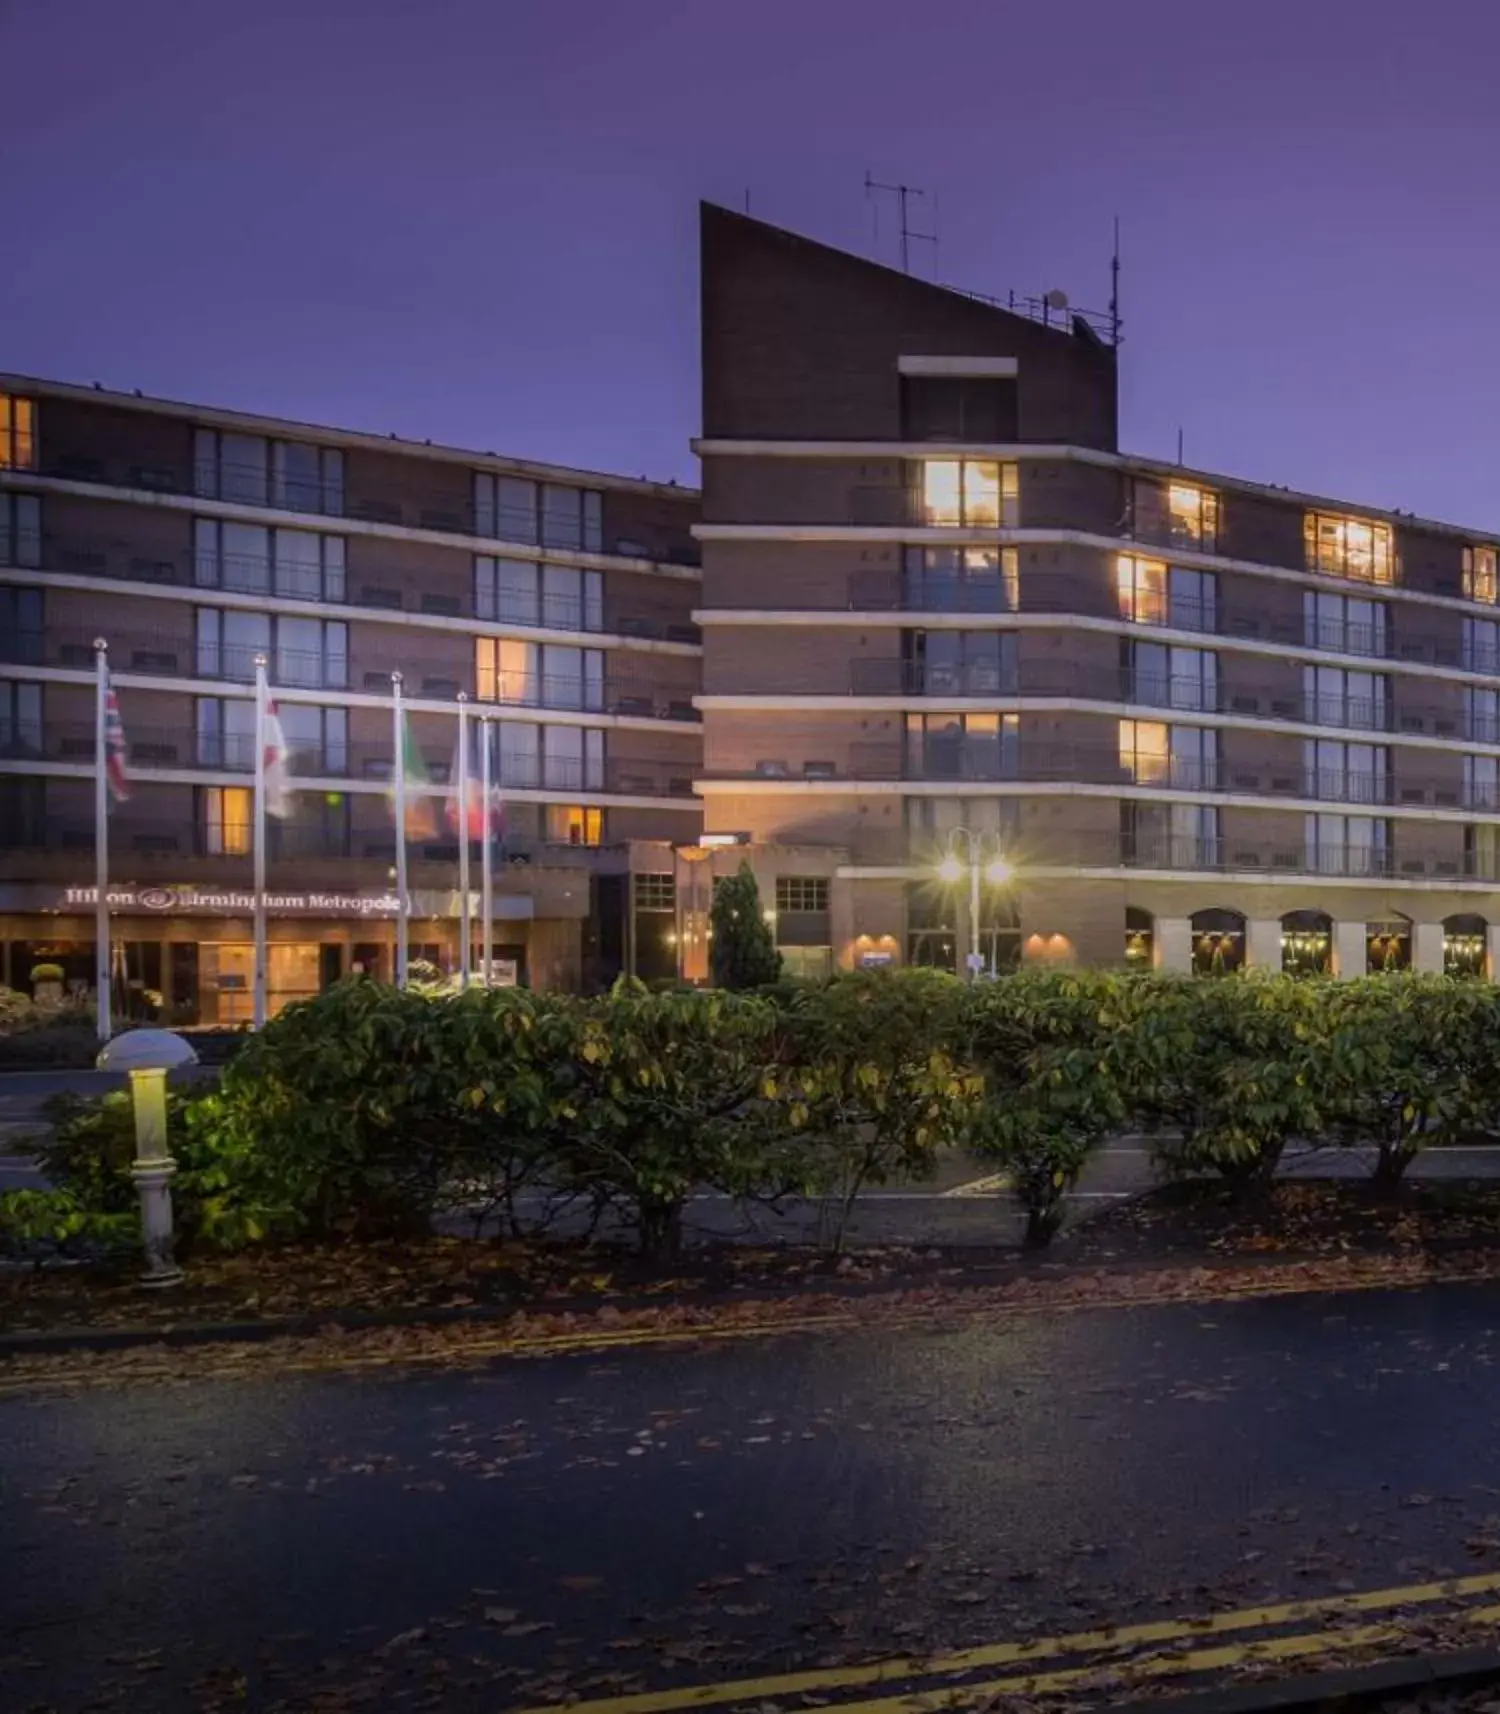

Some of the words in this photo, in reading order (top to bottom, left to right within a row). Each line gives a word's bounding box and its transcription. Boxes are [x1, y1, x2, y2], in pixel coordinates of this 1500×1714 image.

[65, 887, 135, 905] Hilon
[180, 892, 304, 910] irmingham
[308, 893, 401, 913] Metropole
